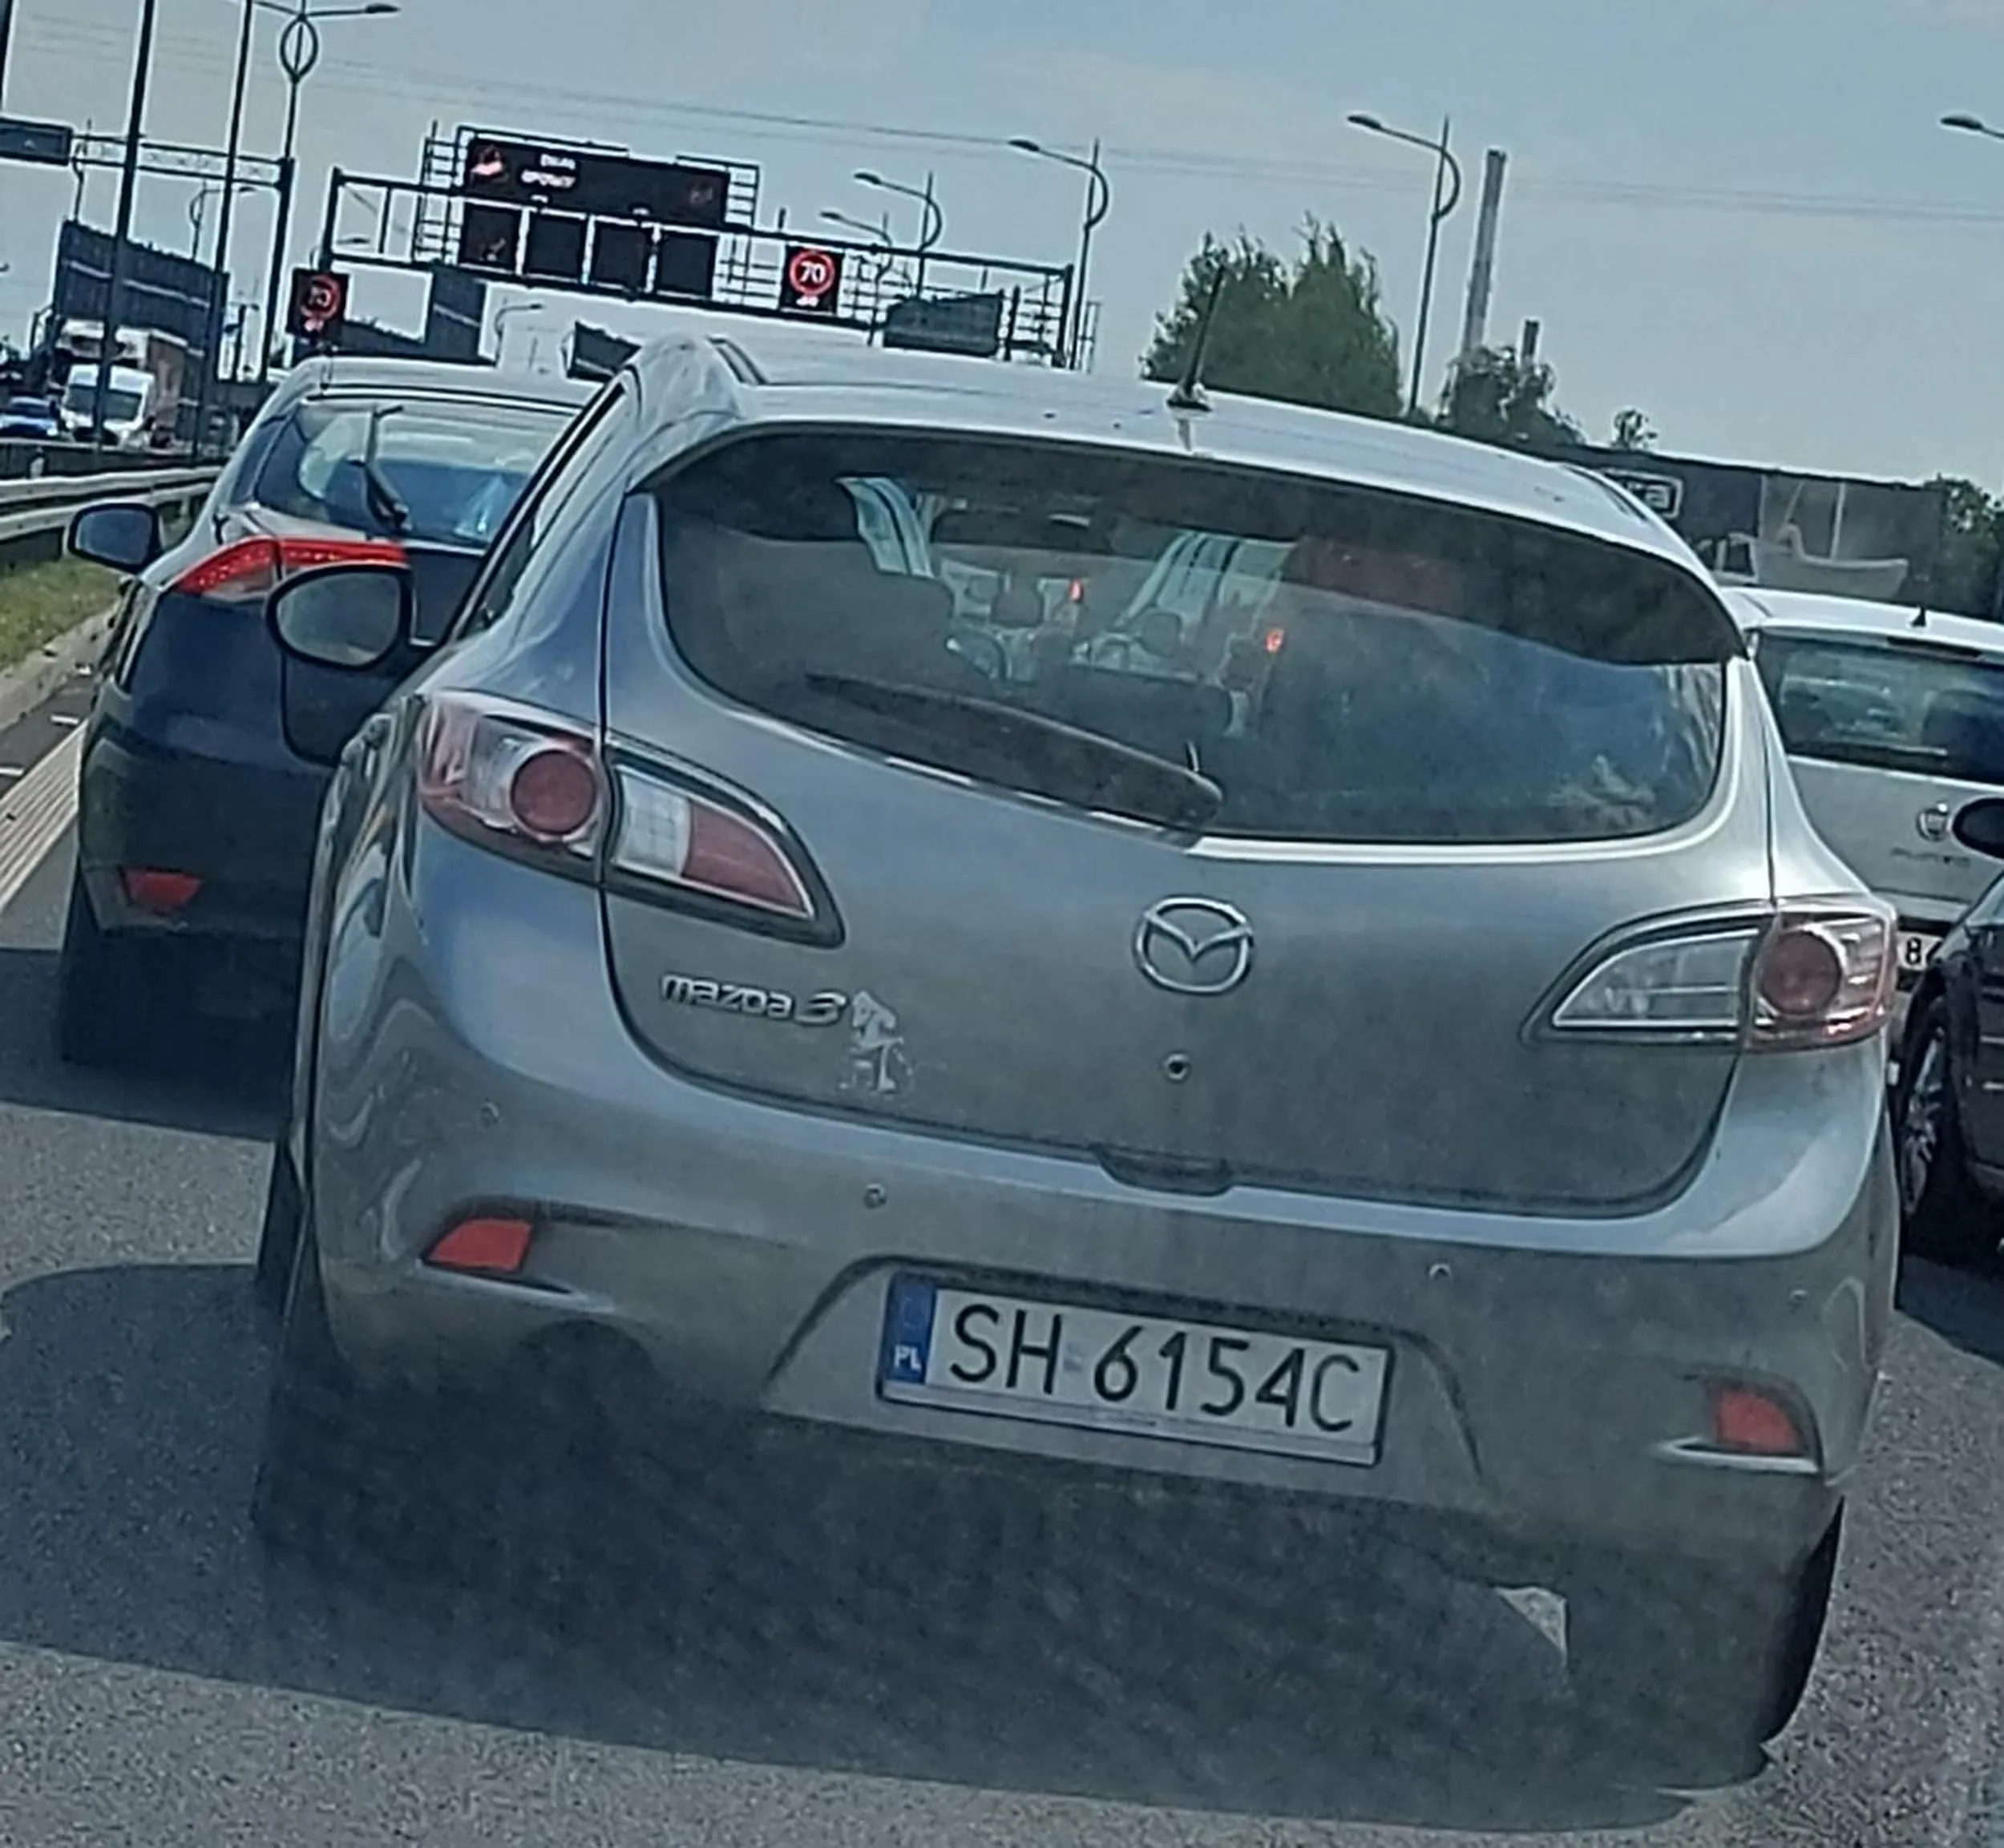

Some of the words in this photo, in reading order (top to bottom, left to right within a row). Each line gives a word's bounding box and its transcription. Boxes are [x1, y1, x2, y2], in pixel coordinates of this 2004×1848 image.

[799, 260, 826, 284] 70
[794, 991, 847, 1025] 3
[894, 1344, 923, 1371] PL
[949, 1303, 1063, 1394] SH
[1093, 1325, 1360, 1433] 6154C
